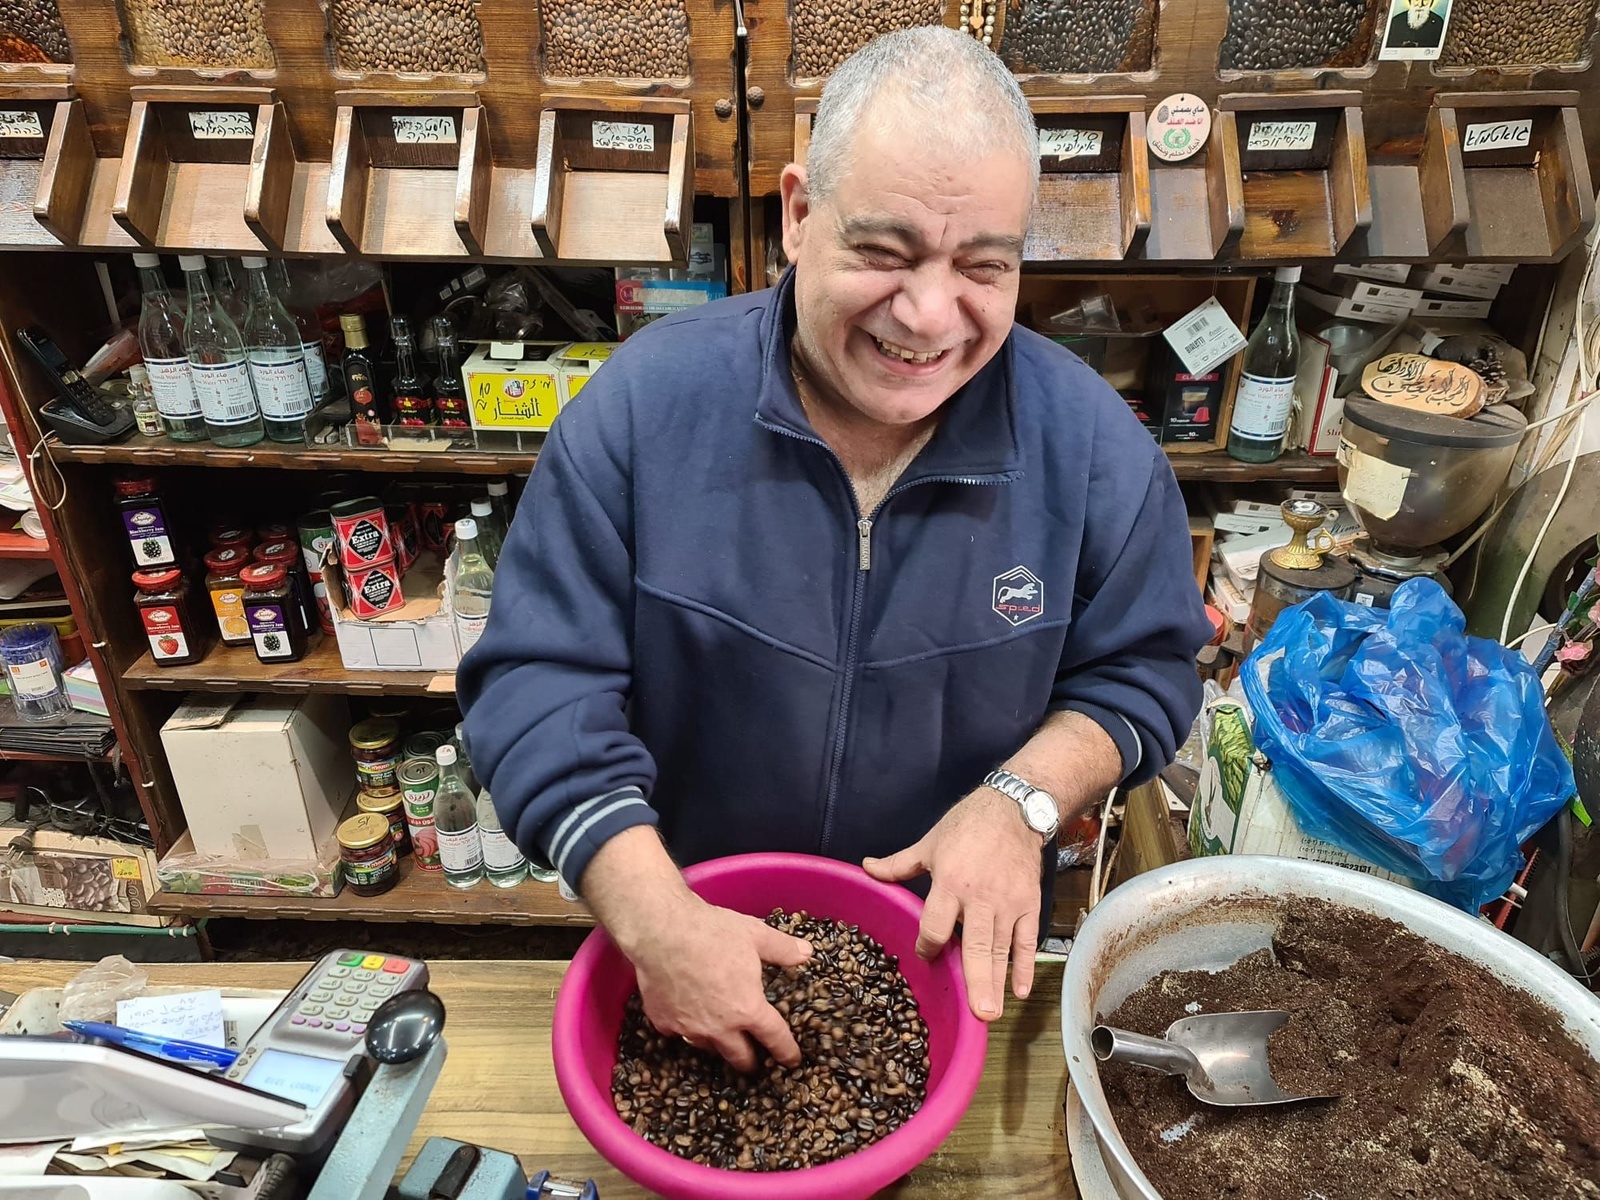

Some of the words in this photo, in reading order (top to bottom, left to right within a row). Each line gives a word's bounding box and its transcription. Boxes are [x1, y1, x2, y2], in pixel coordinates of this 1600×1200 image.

[1184, 335, 1206, 354] BIALETTI
[494, 397, 542, 421] الشنار
[351, 529, 380, 545] Extra
[363, 579, 392, 594] Extra
